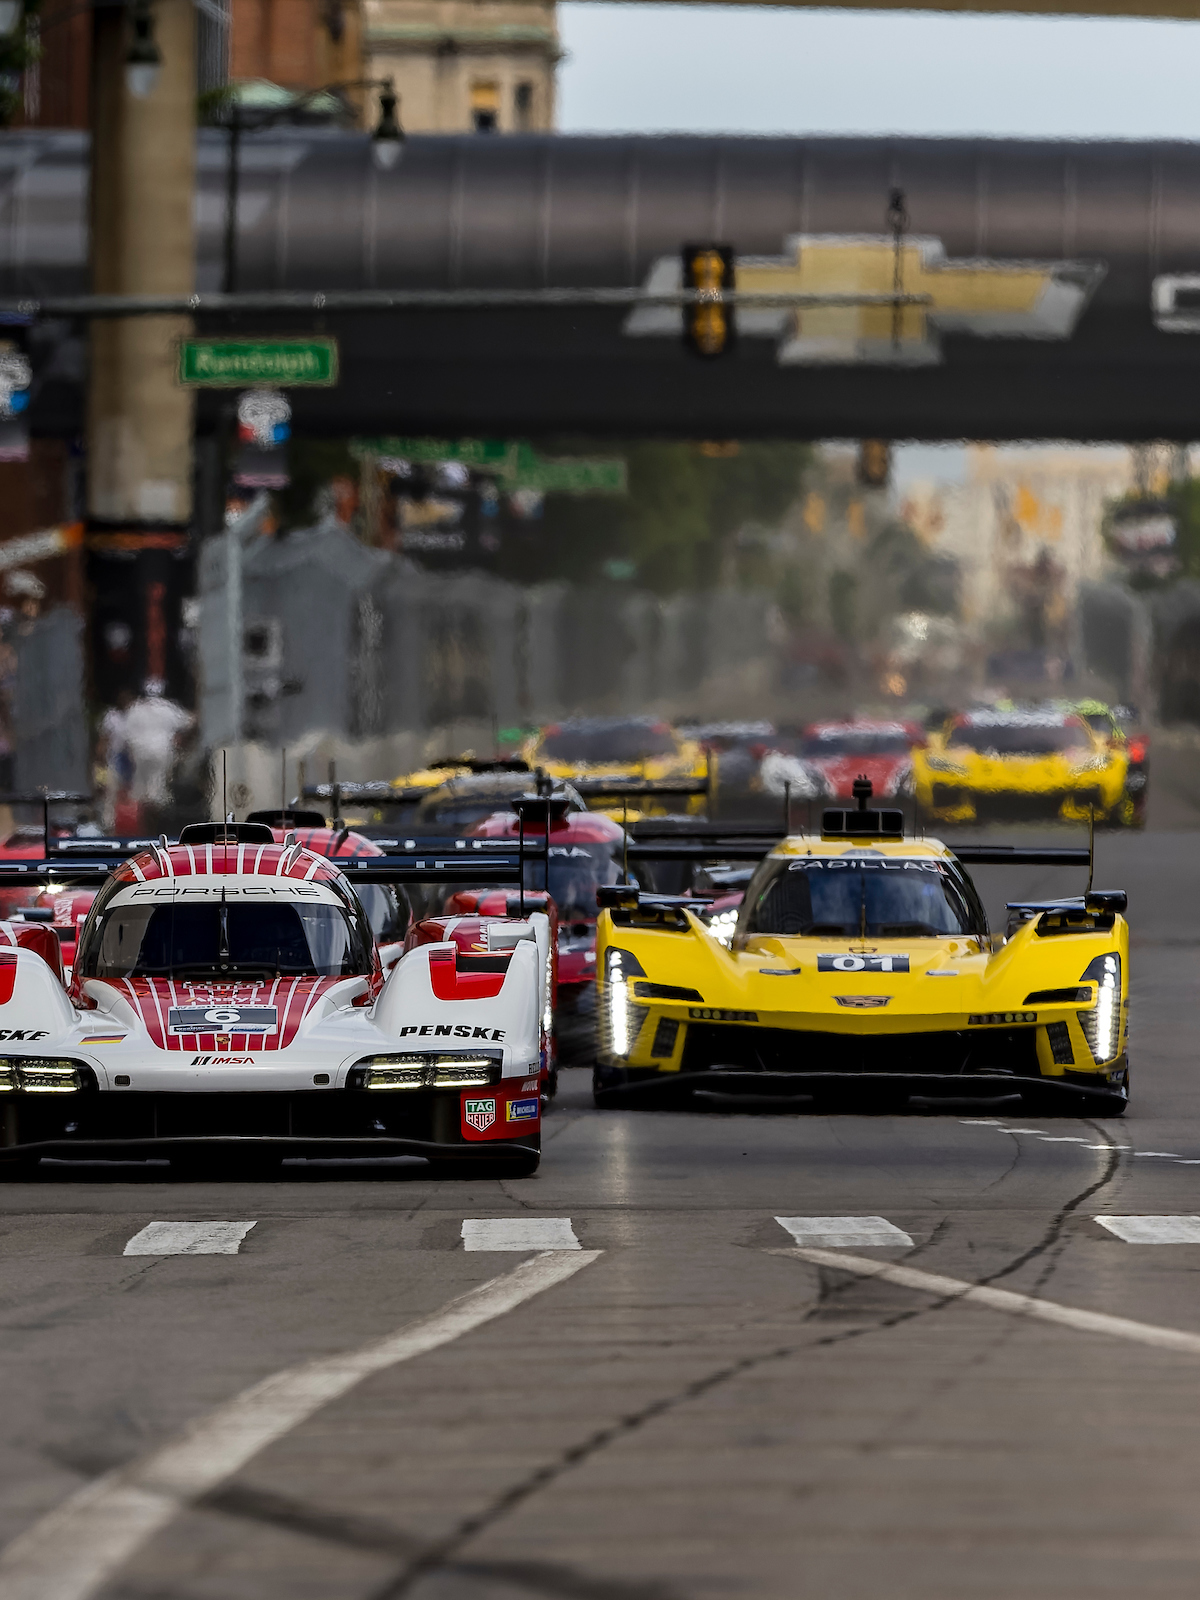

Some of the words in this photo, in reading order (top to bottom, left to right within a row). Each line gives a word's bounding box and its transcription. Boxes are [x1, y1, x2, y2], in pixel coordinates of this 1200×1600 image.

[788, 860, 939, 873] CADILLAC
[130, 887, 320, 898] PORSCHE
[832, 957, 893, 972] 01
[204, 1008, 241, 1024] 6
[400, 1025, 507, 1042] PENSKE
[211, 1057, 256, 1065] IMSA
[469, 1101, 494, 1112] TAG
[467, 1113, 495, 1130] HEUER
